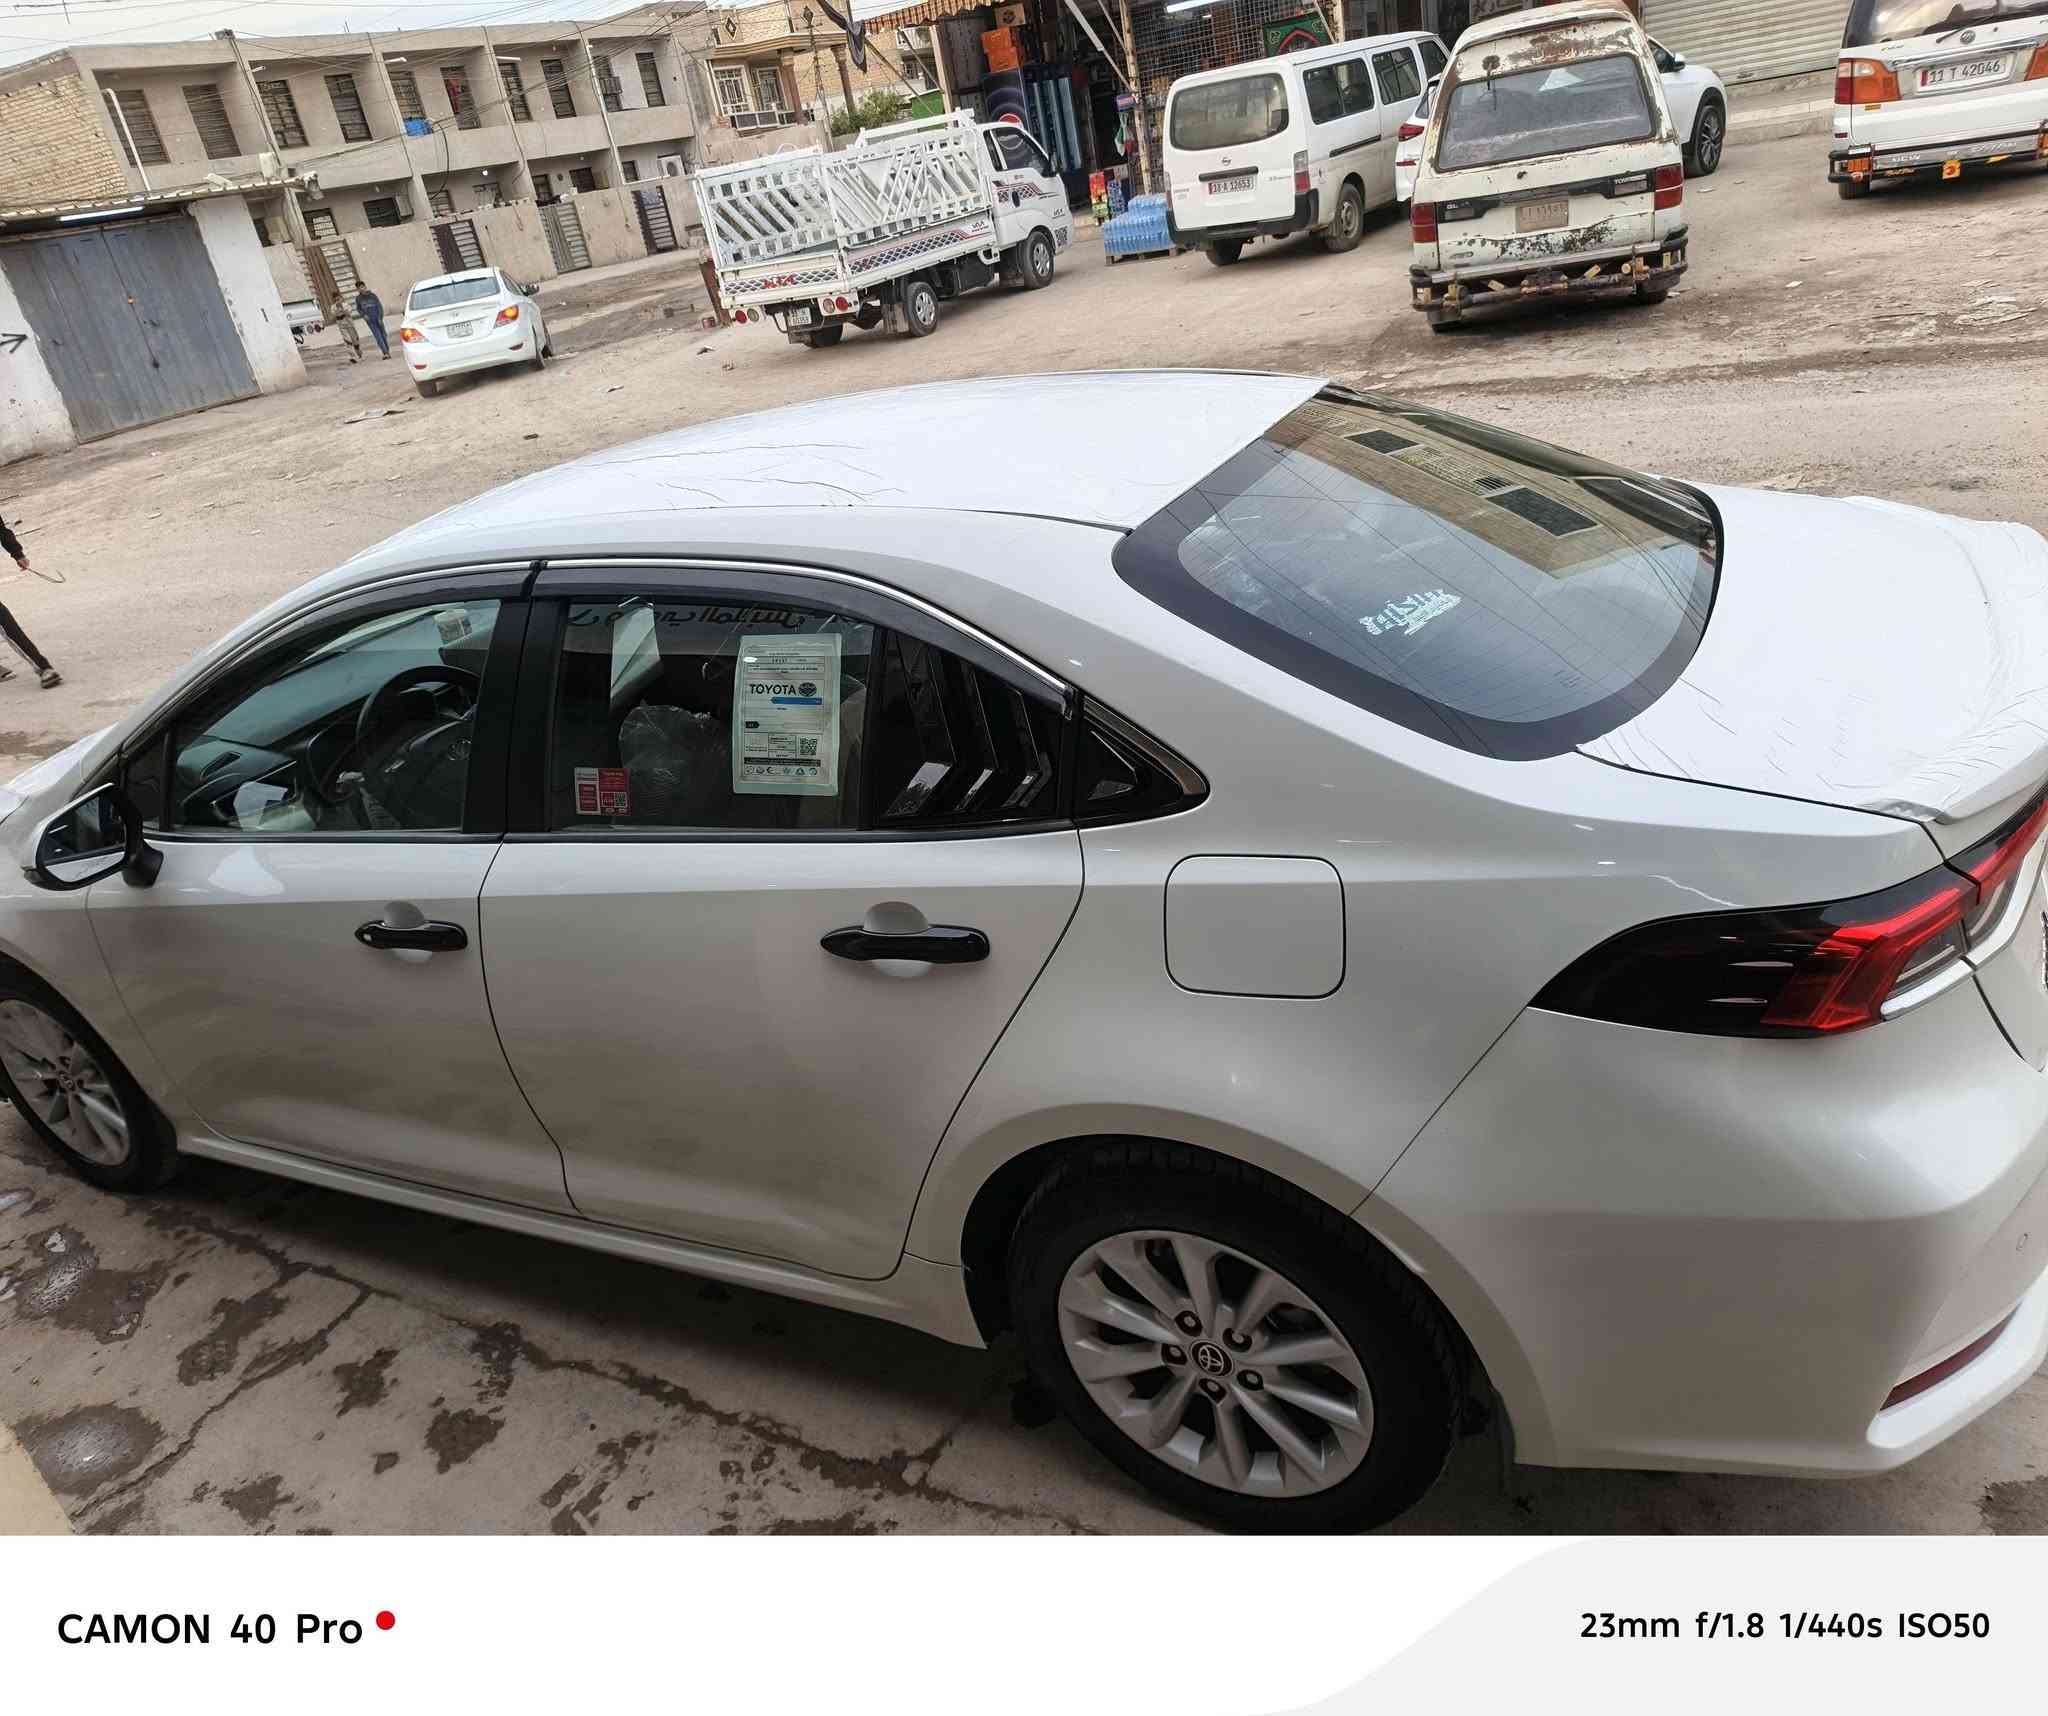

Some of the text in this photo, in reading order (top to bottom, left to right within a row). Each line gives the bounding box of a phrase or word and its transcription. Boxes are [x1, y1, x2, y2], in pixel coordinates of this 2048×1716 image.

[1929, 69, 1944, 82] 11
[1962, 60, 2000, 77] 42046
[749, 683, 797, 695] TOYOTA
